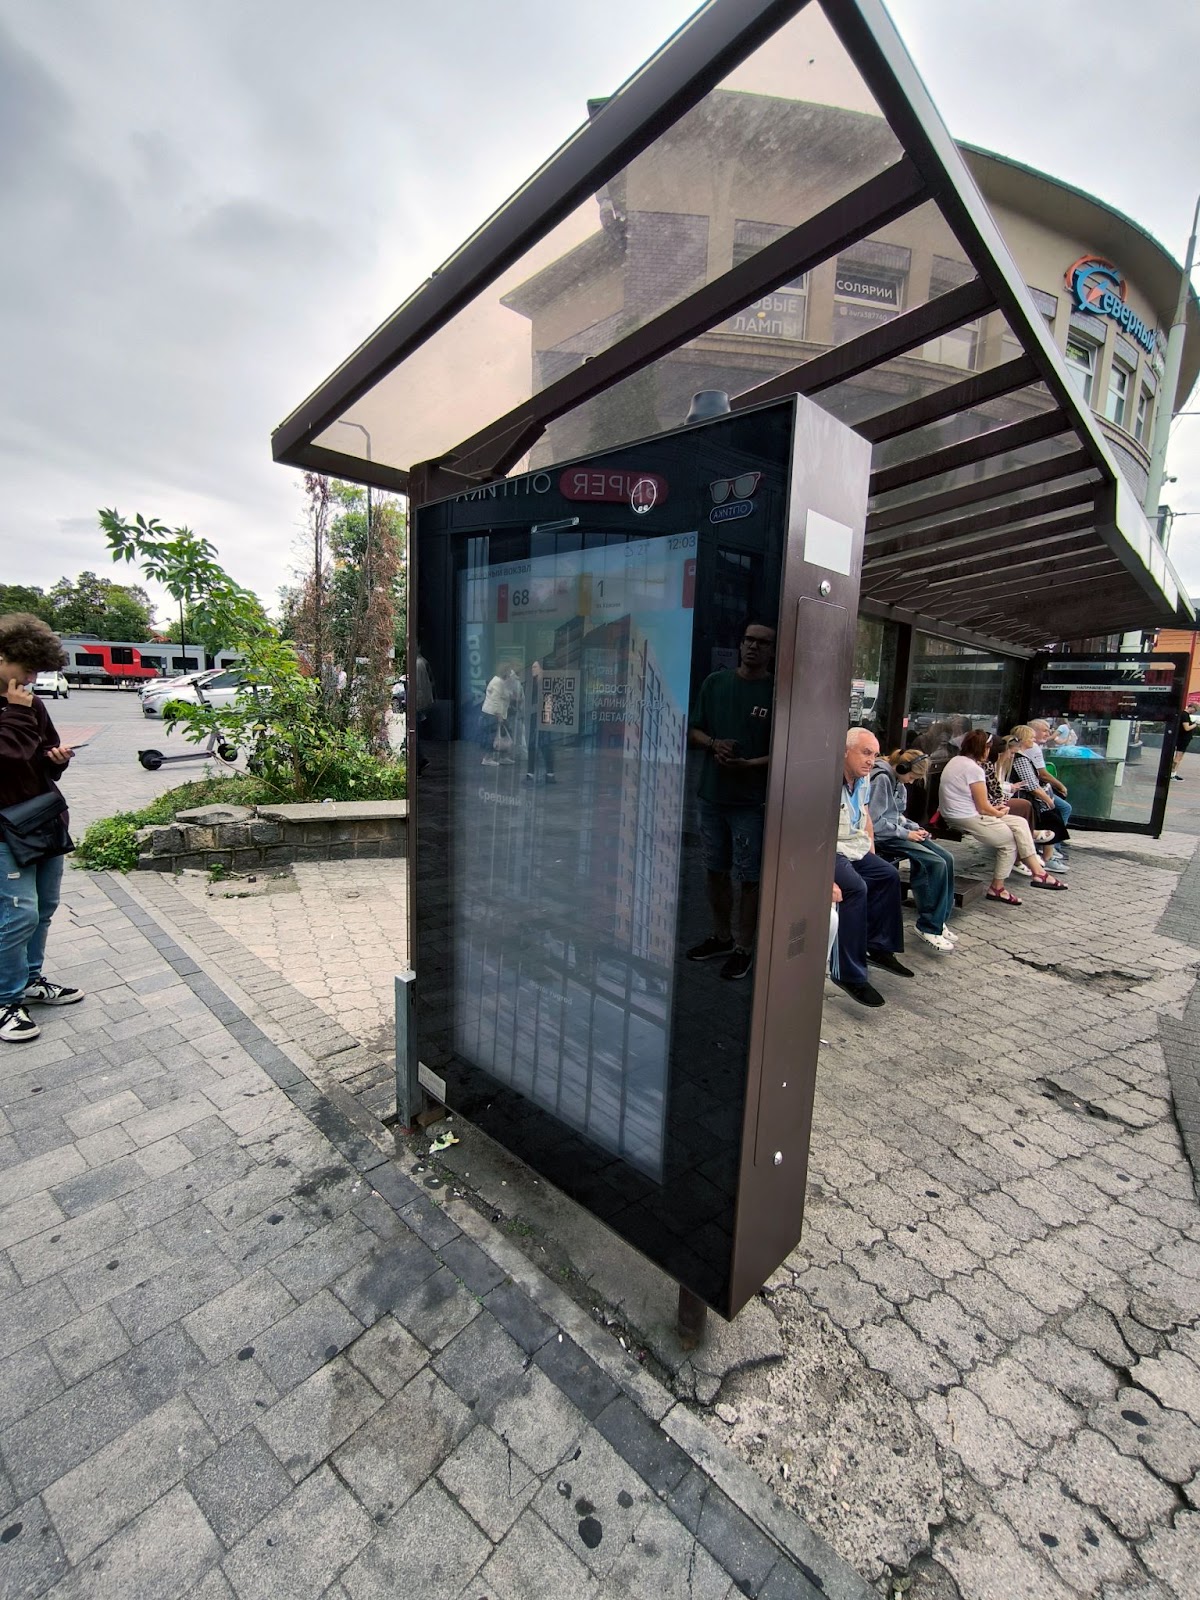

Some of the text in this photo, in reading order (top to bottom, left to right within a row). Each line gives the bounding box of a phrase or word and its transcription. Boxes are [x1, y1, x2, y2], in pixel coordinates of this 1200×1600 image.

[836, 280, 893, 299] СОЛЯРИИ
[733, 316, 797, 337] ЛАМПЫ
[668, 536, 696, 550] 12:03
[596, 580, 604, 597] 1
[512, 589, 530, 606] 68
